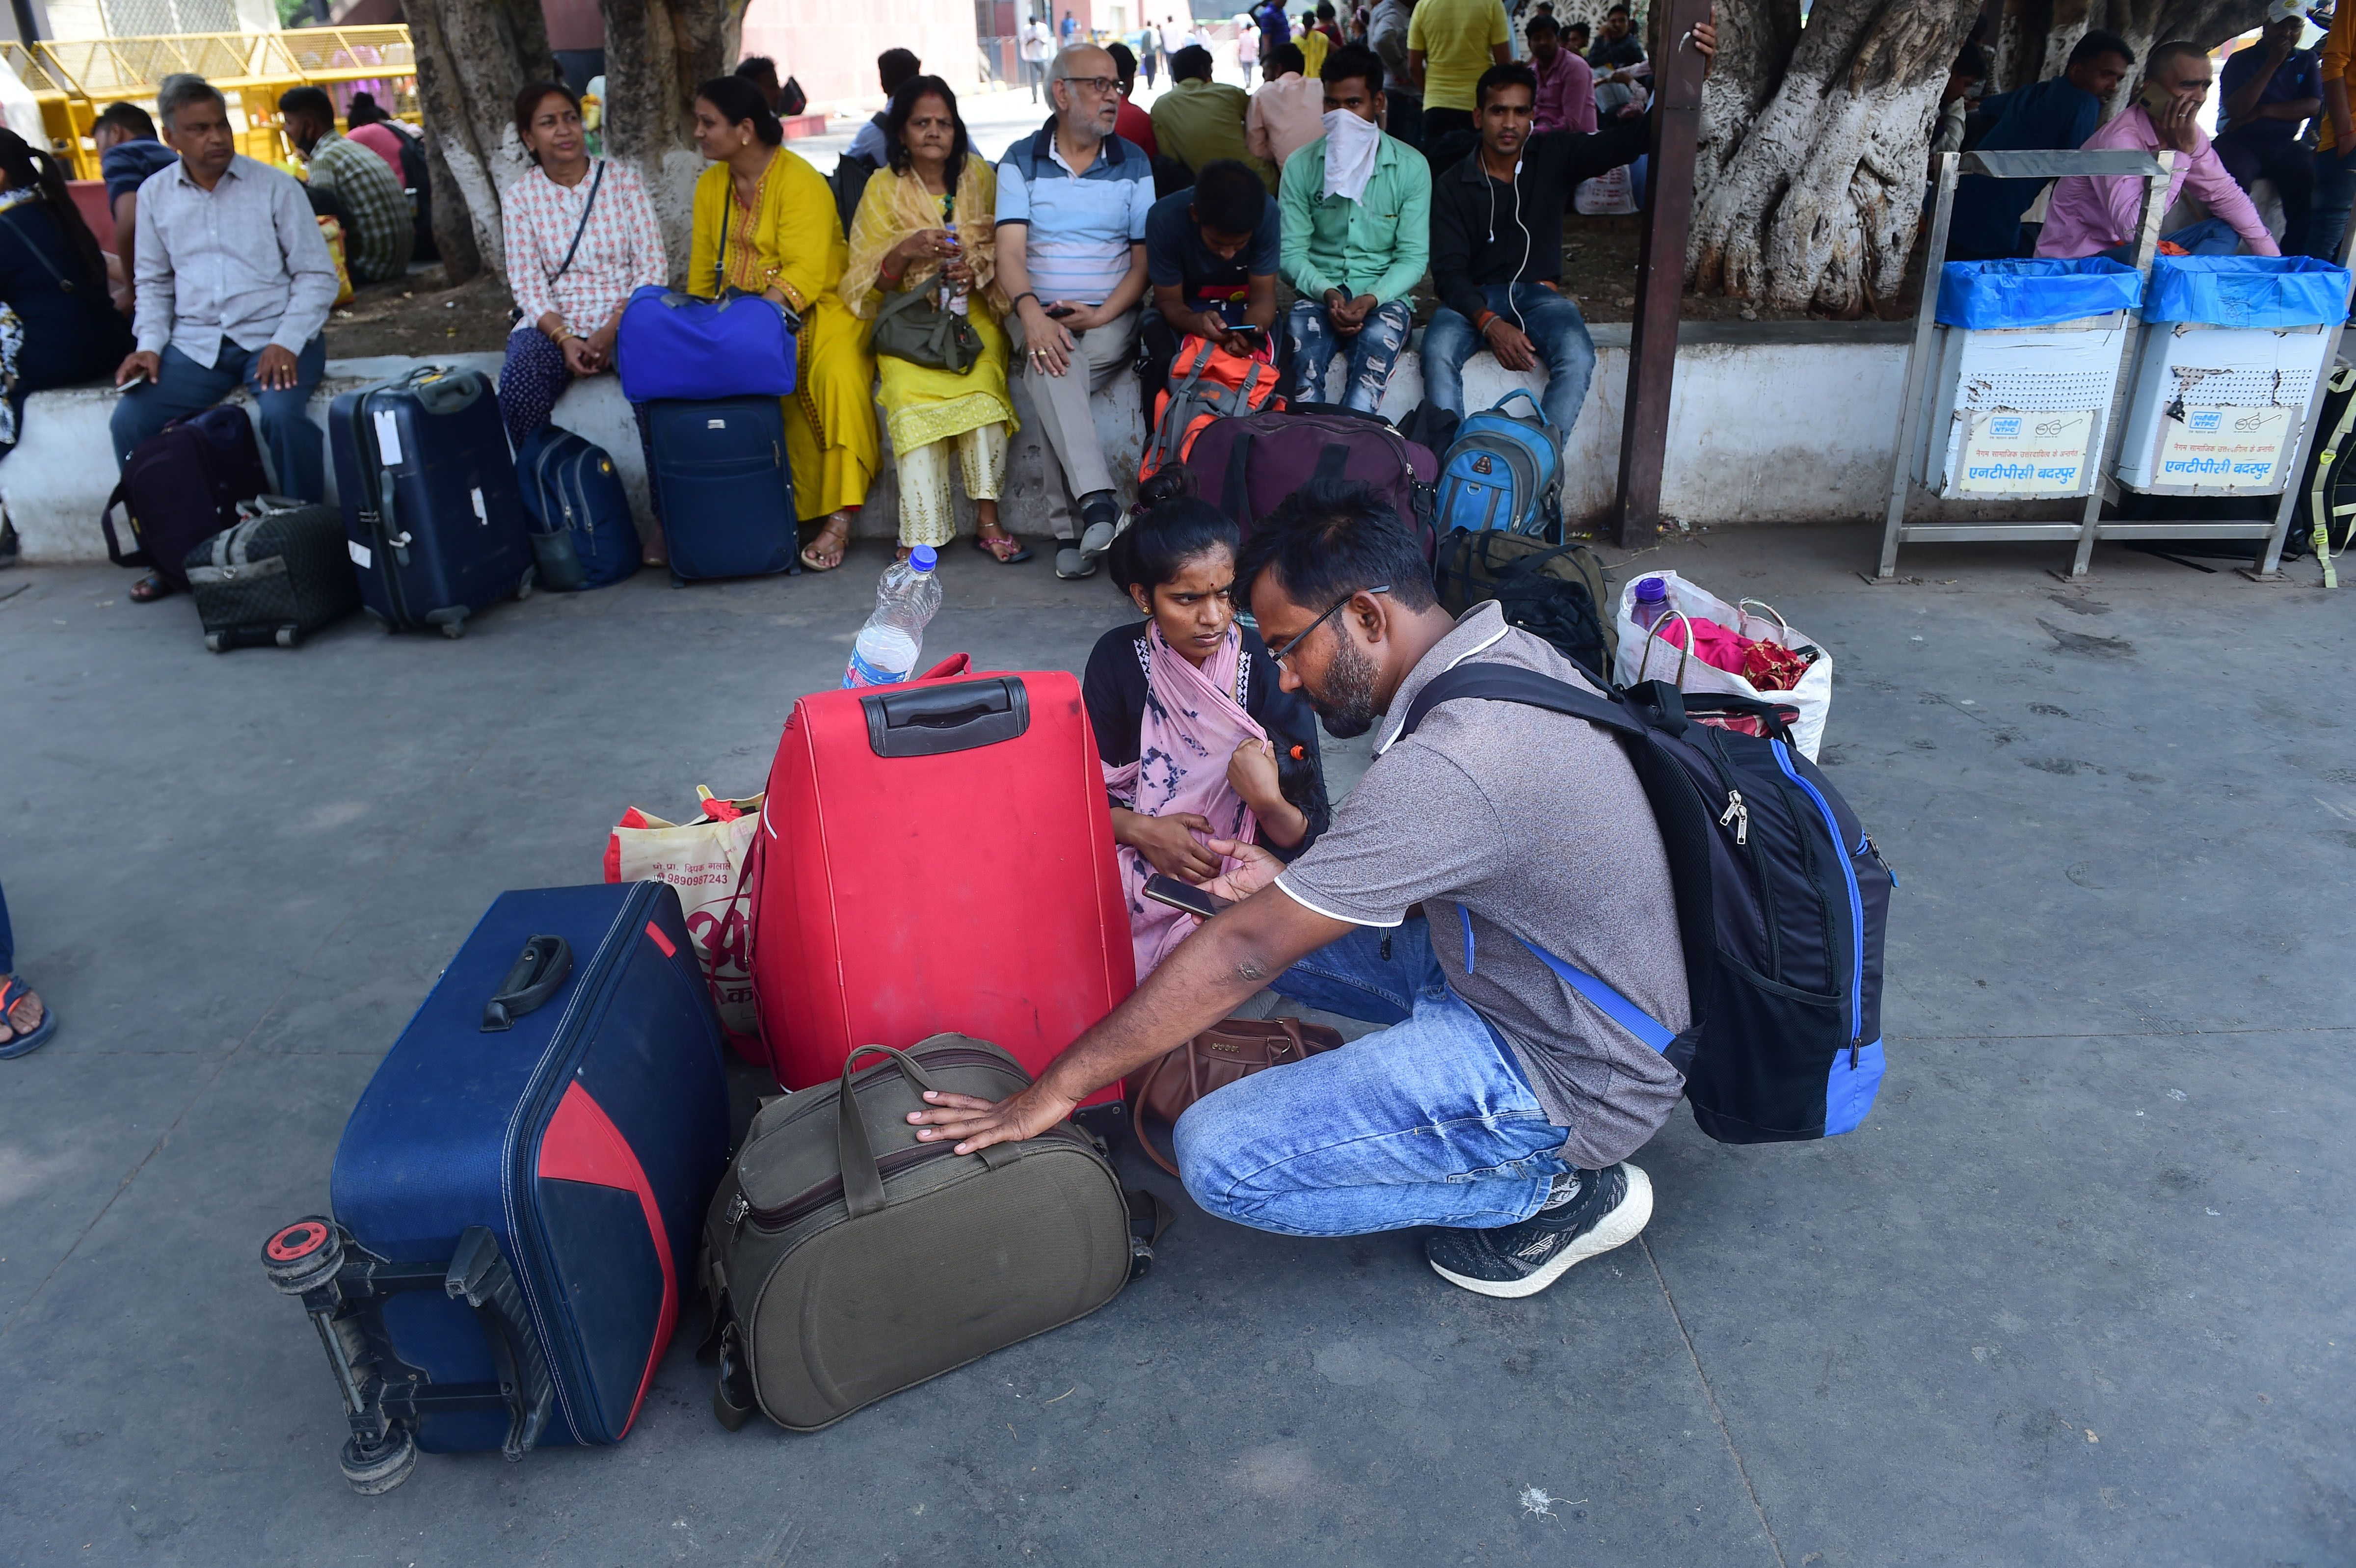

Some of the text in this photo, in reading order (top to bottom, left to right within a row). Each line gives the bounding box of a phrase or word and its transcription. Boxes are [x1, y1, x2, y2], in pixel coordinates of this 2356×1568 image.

[1992, 449, 2018, 457] सामाजिक
[1969, 464, 2077, 484] एनटीपीसी बदरपुर
[2233, 463, 2272, 479] बदरपुर
[684, 864, 705, 874] दिपक
[708, 860, 731, 870] गलाले
[668, 874, 727, 886] 9890987243
